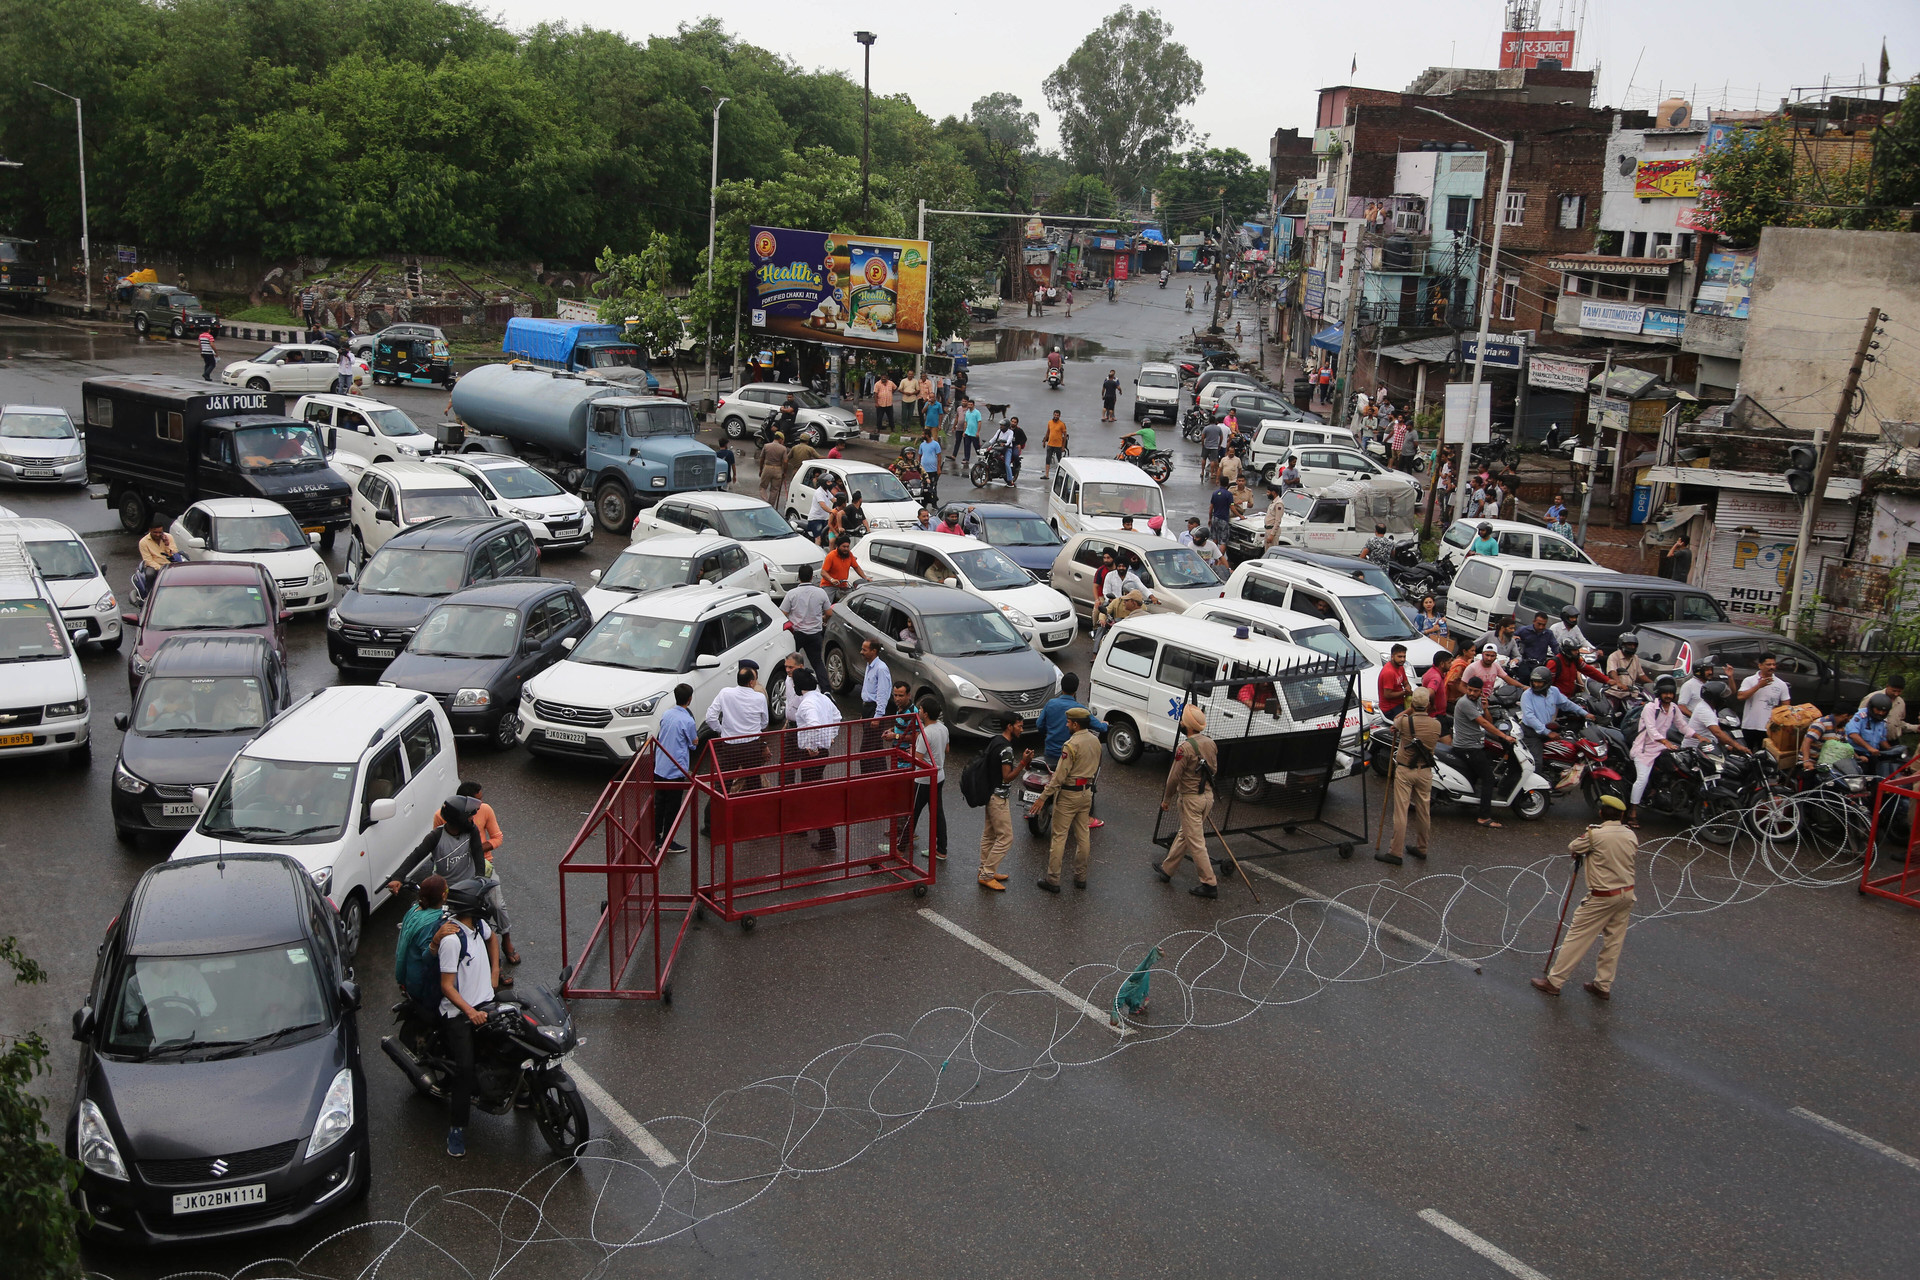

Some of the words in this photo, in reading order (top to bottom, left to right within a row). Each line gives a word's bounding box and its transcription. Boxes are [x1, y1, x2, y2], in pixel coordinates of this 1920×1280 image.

[1548, 261, 1579, 270] TAWI
[1581, 261, 1669, 275] AUTOMOVERS
[761, 293, 786, 304] FORTIFIED
[786, 291, 804, 299] CHAKKI
[1583, 306, 1601, 317] TAWI
[1601, 308, 1642, 321] AUTOMOVERS
[1506, 335, 1526, 345] STORE
[206, 397, 230, 410] J&K
[233, 395, 268, 409] POLICE
[304, 483, 330, 491] POLICE
[11, 735, 30, 744] 8959
[549, 731, 585, 742] JK02BW2222
[170, 805, 195, 814] JK21C
[183, 1187, 264, 1210] JK02BN1114
